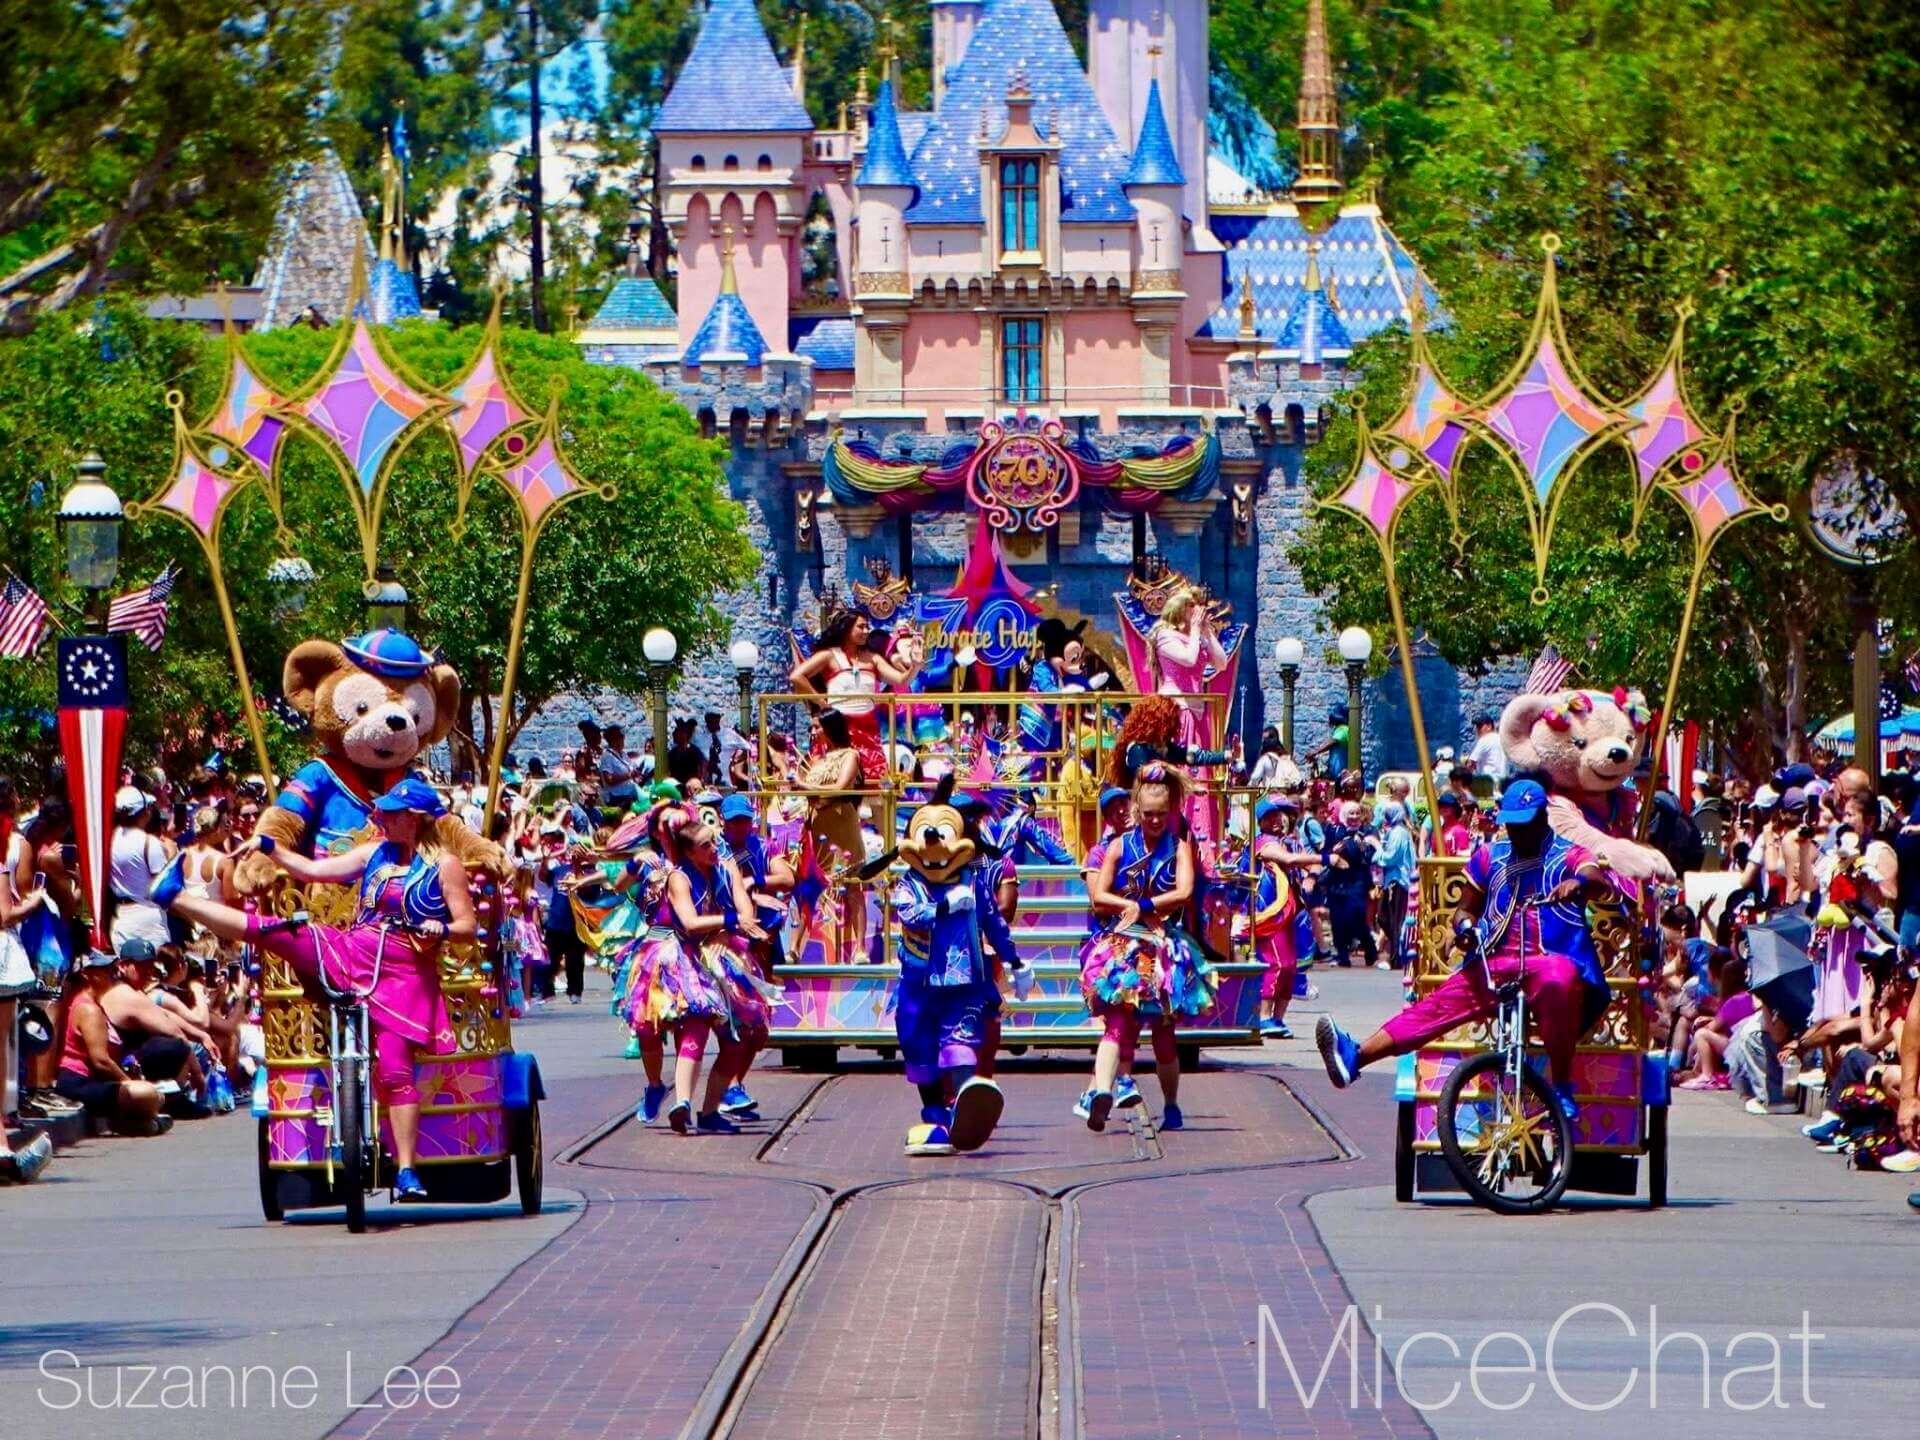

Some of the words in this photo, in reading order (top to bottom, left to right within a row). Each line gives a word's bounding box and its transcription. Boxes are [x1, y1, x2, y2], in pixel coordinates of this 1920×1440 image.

[997, 456, 1047, 487] 70
[914, 595, 1029, 669] 70
[926, 623, 993, 649] ebrate
